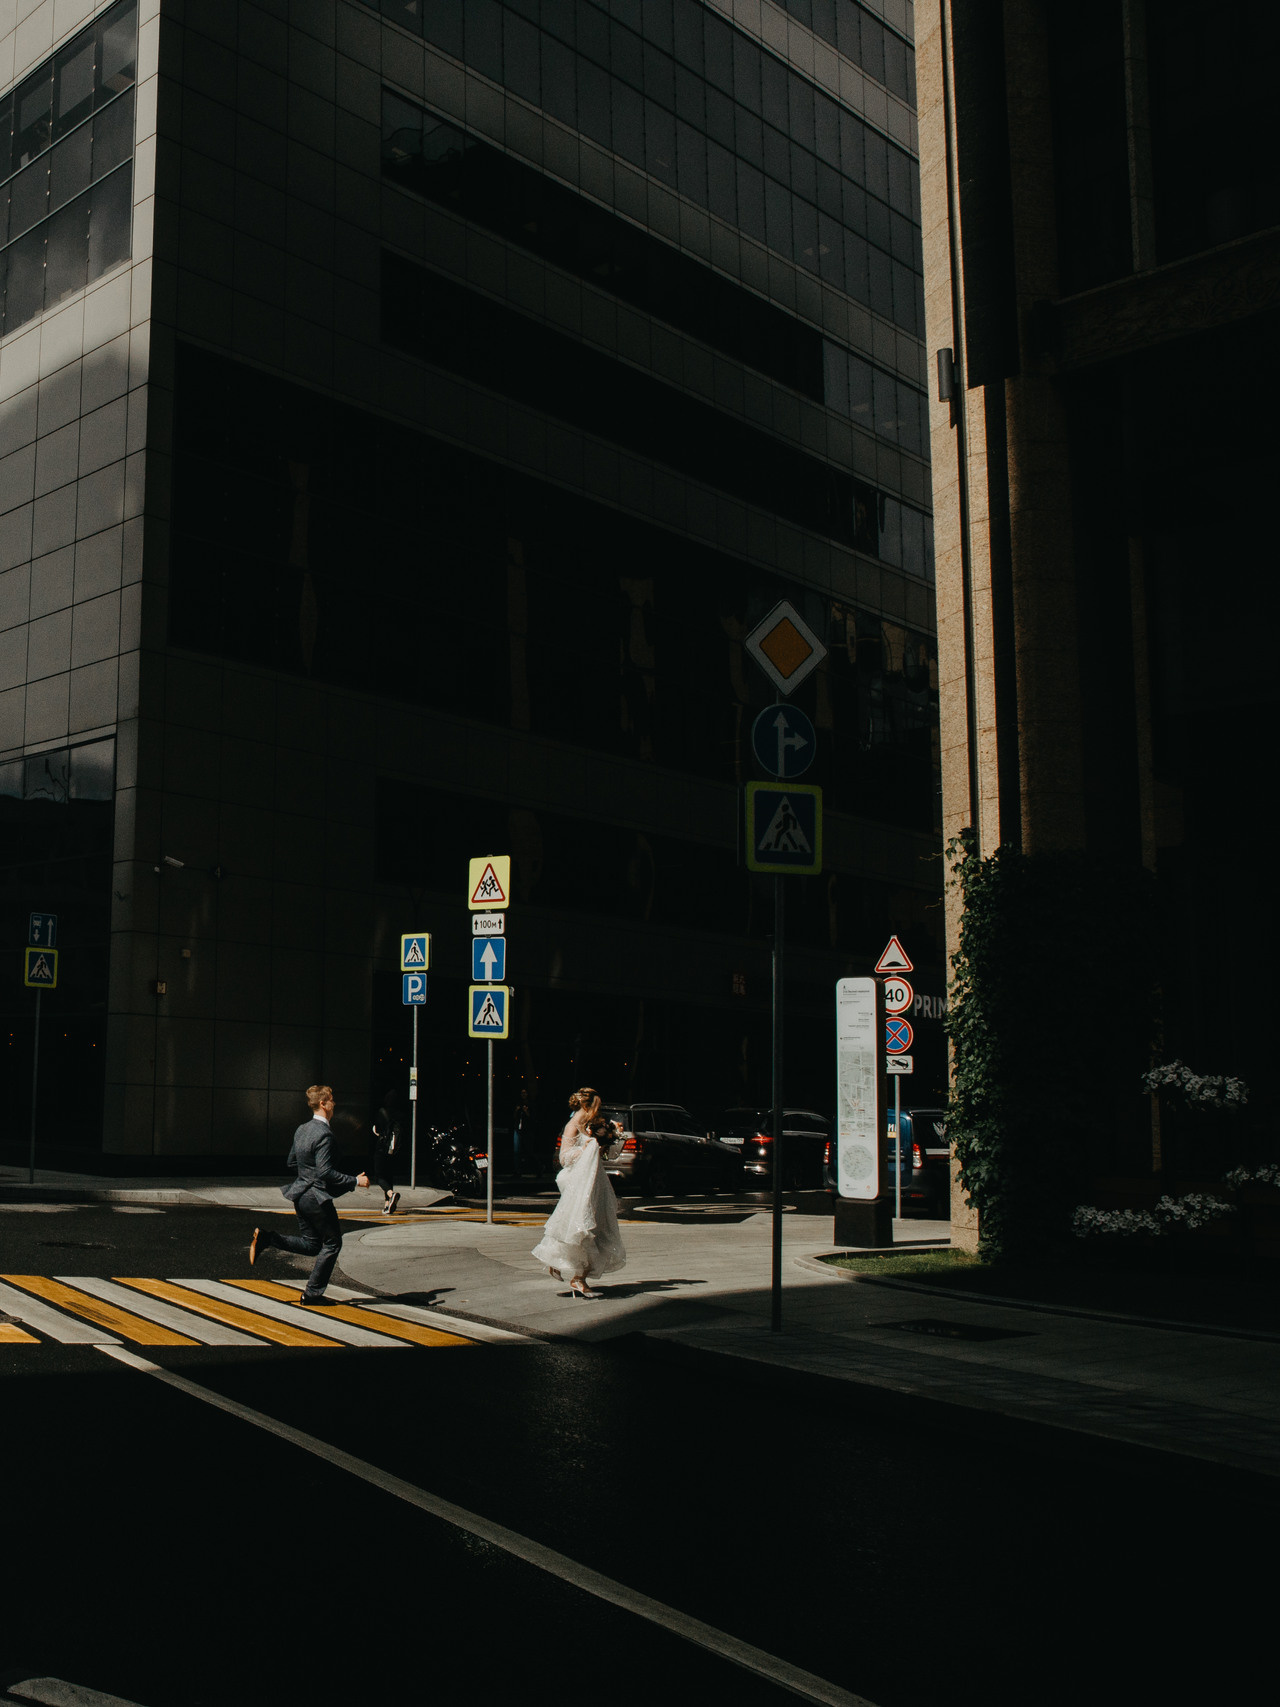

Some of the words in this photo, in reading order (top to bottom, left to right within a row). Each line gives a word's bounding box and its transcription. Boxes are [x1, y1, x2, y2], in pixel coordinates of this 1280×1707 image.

[480, 920, 497, 929] 100м
[408, 976, 423, 1002] P
[885, 988, 904, 1002] 40
